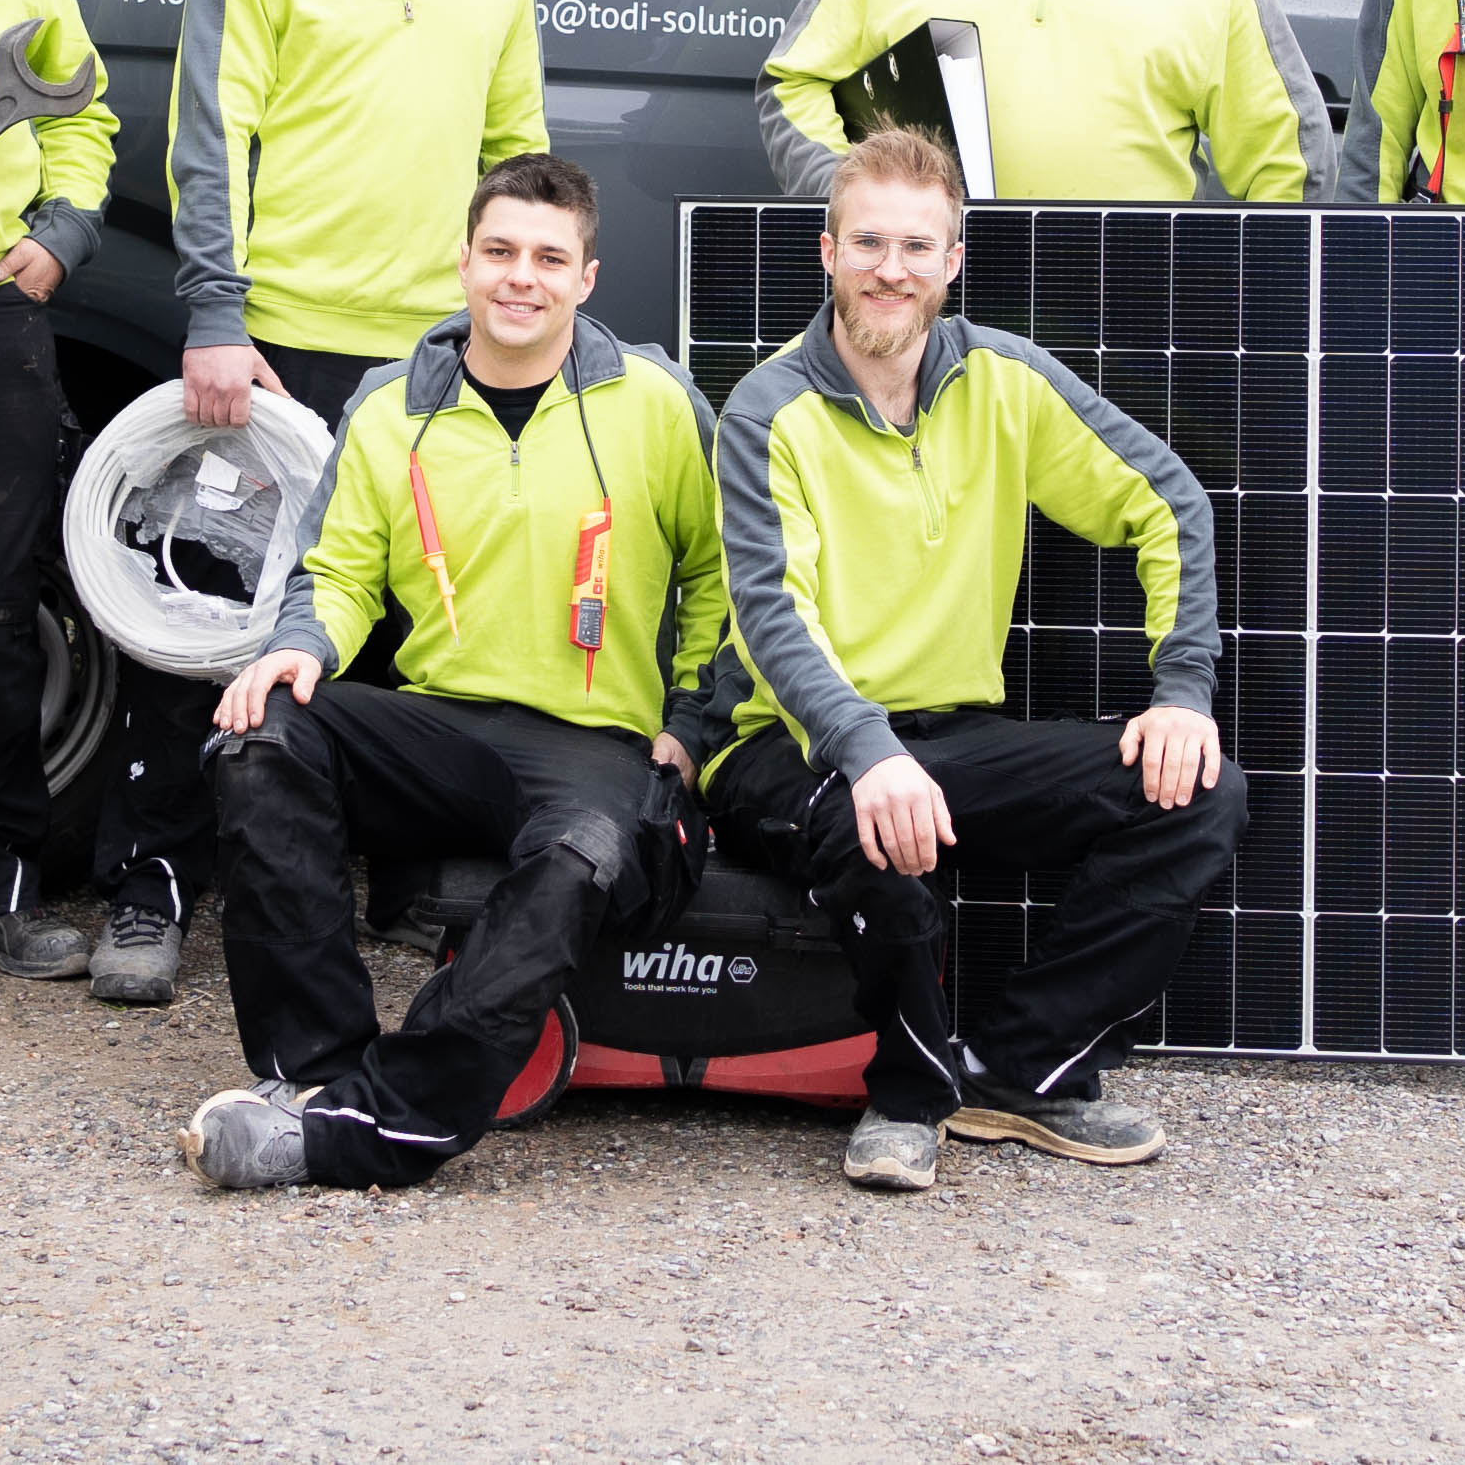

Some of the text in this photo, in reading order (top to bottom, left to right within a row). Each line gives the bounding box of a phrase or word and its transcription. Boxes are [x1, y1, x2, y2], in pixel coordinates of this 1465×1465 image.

[623, 942, 724, 982] wiha
[623, 982, 718, 996] Tools that work for you
